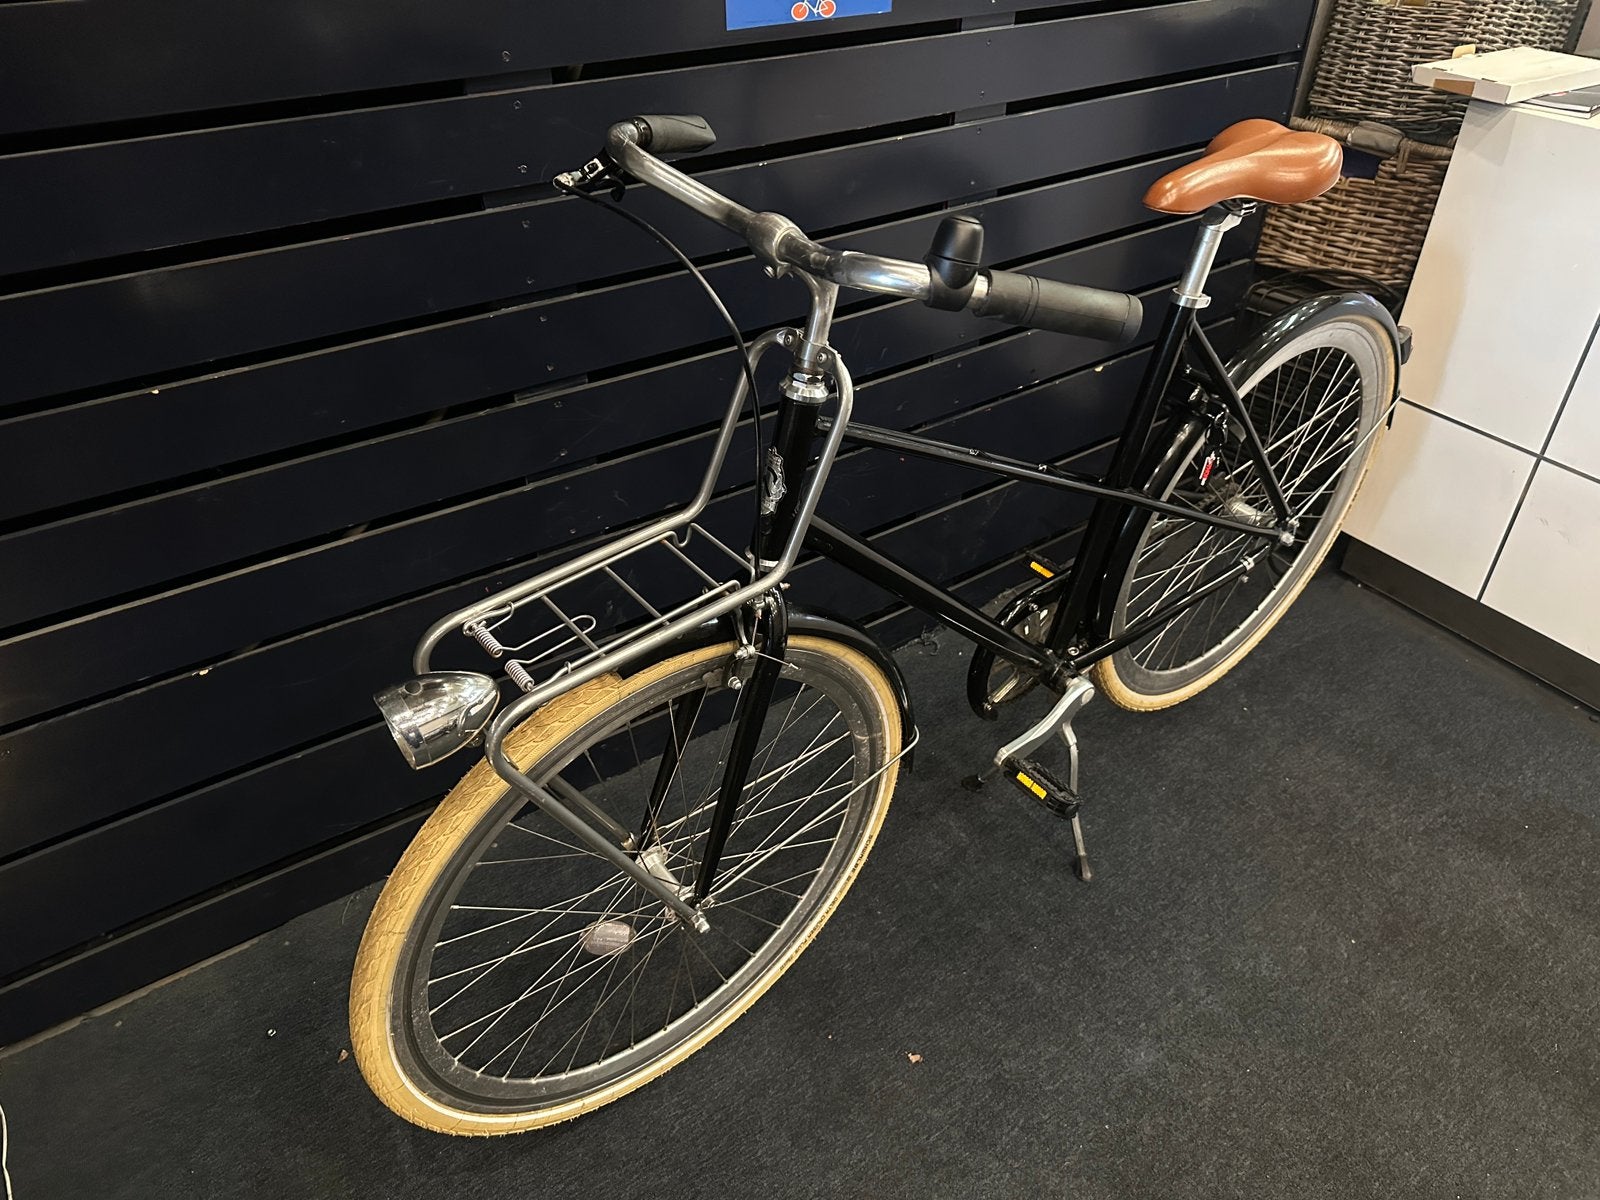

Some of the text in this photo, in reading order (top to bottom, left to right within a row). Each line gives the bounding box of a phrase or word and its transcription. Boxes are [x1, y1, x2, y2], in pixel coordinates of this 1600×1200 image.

[852, 834, 873, 873] SCHWALBE
[825, 896, 838, 914] DELTA
[807, 915, 826, 938] CRUISER
